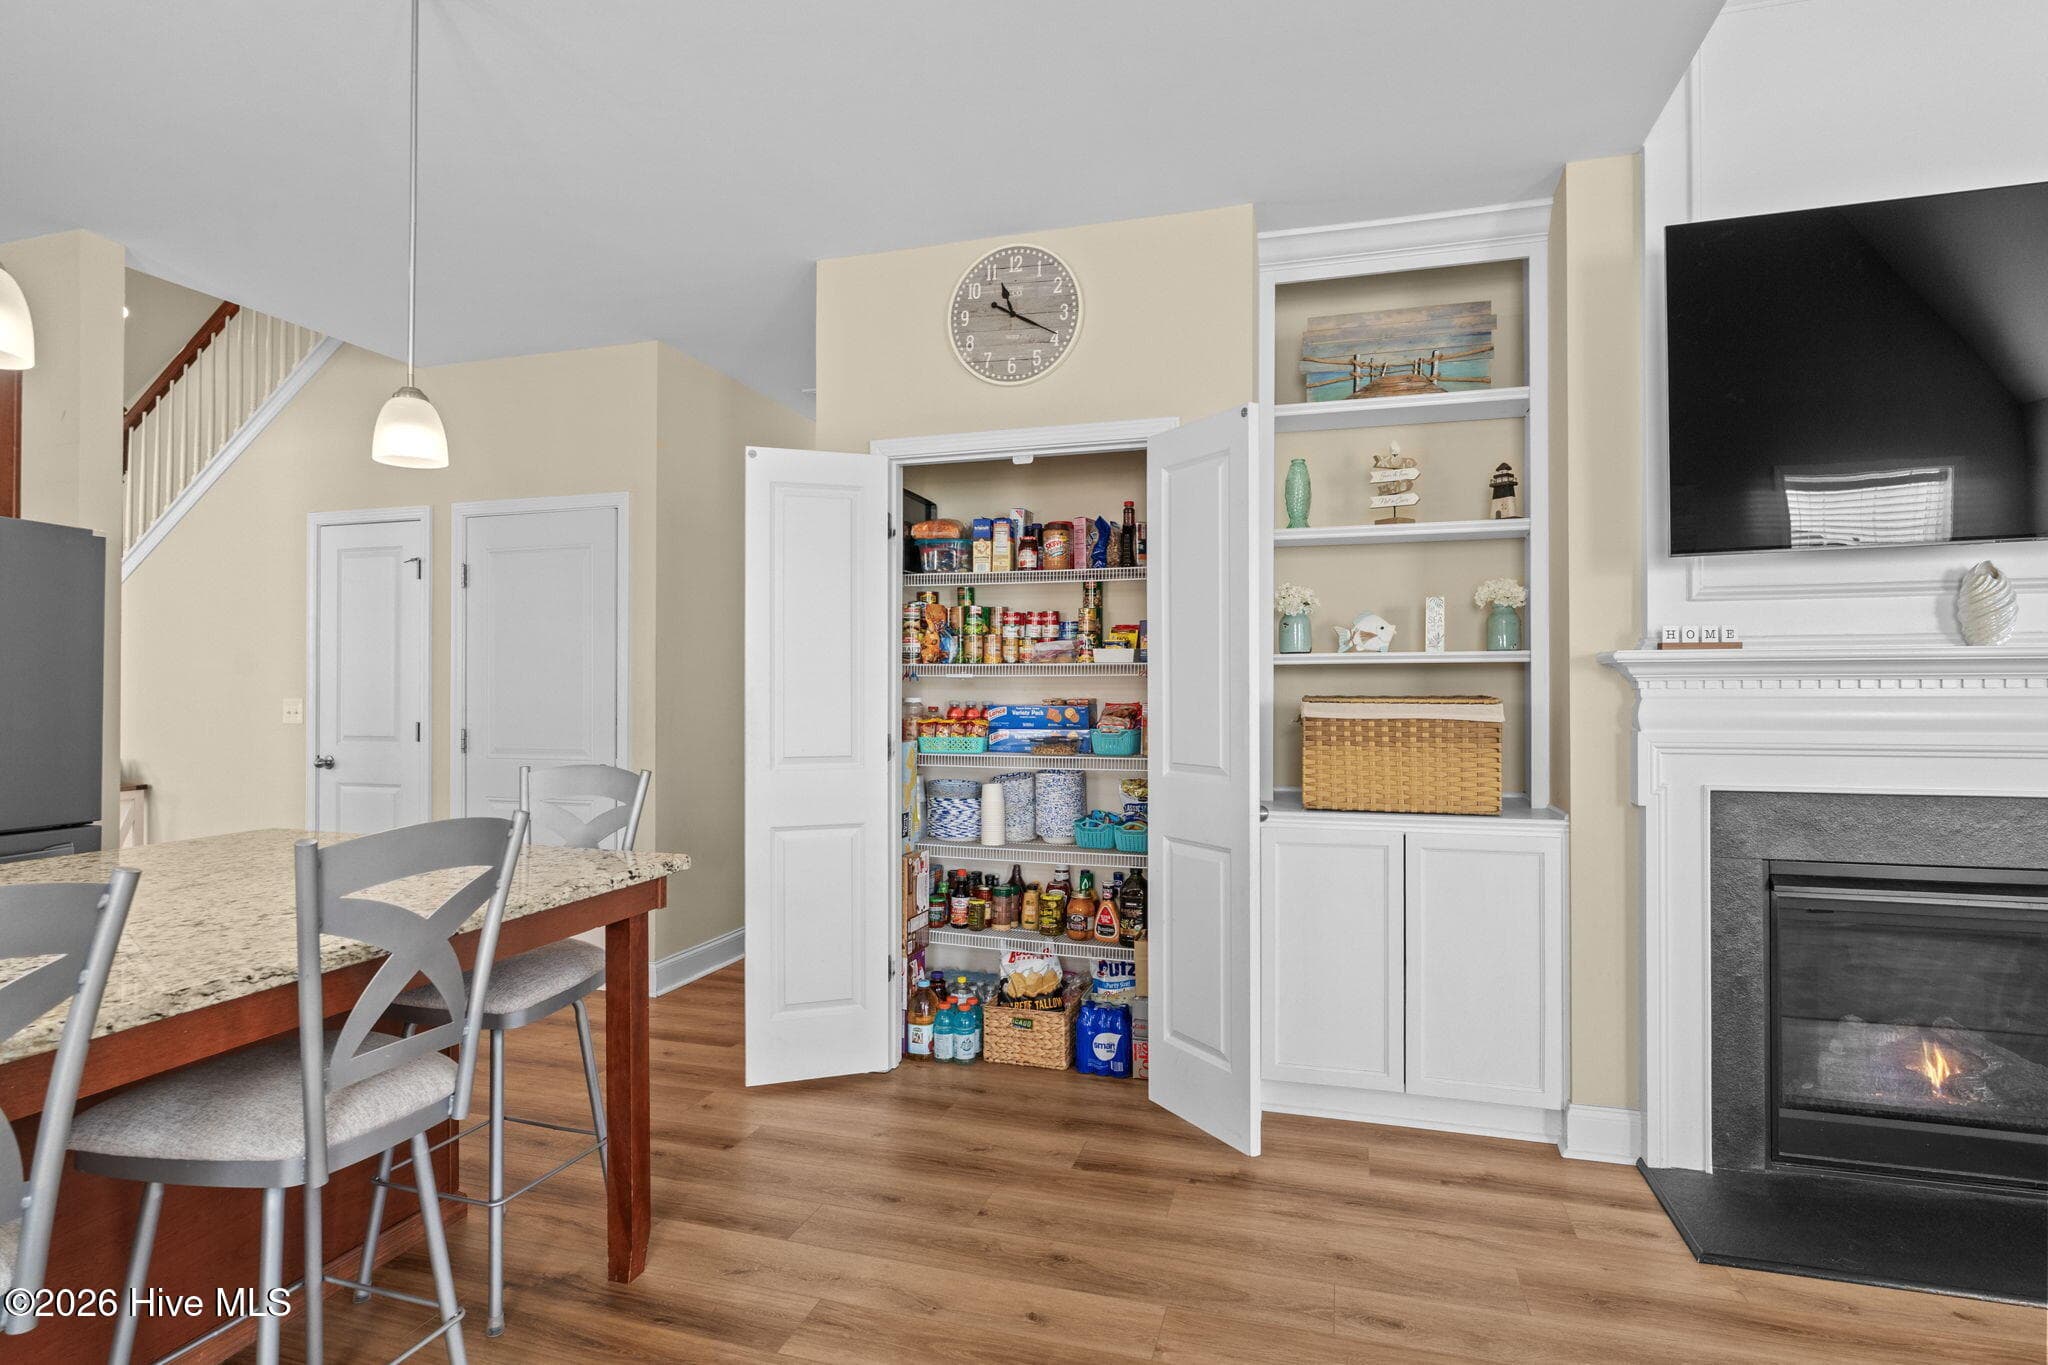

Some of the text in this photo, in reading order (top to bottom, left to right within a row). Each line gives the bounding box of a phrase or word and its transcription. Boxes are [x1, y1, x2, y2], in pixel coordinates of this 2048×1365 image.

[986, 263, 997, 281] 11
[1008, 255, 1023, 273] 12
[1036, 260, 1042, 277] 1
[967, 282, 981, 300] 10
[1053, 277, 1063, 293] 2
[960, 310, 969, 327] 9
[1059, 303, 1069, 320] 3
[966, 335, 975, 352] 8
[1050, 330, 1059, 347] 4
[984, 352, 992, 369] 7
[1007, 357, 1017, 374] 6
[1032, 349, 1042, 366] 5
[1665, 629, 1735, 640] HOME
[988, 707, 1006, 718] Lance
[1012, 709, 1030, 717] Variety
[1014, 997, 1063, 1009] BEEF TALLOW
